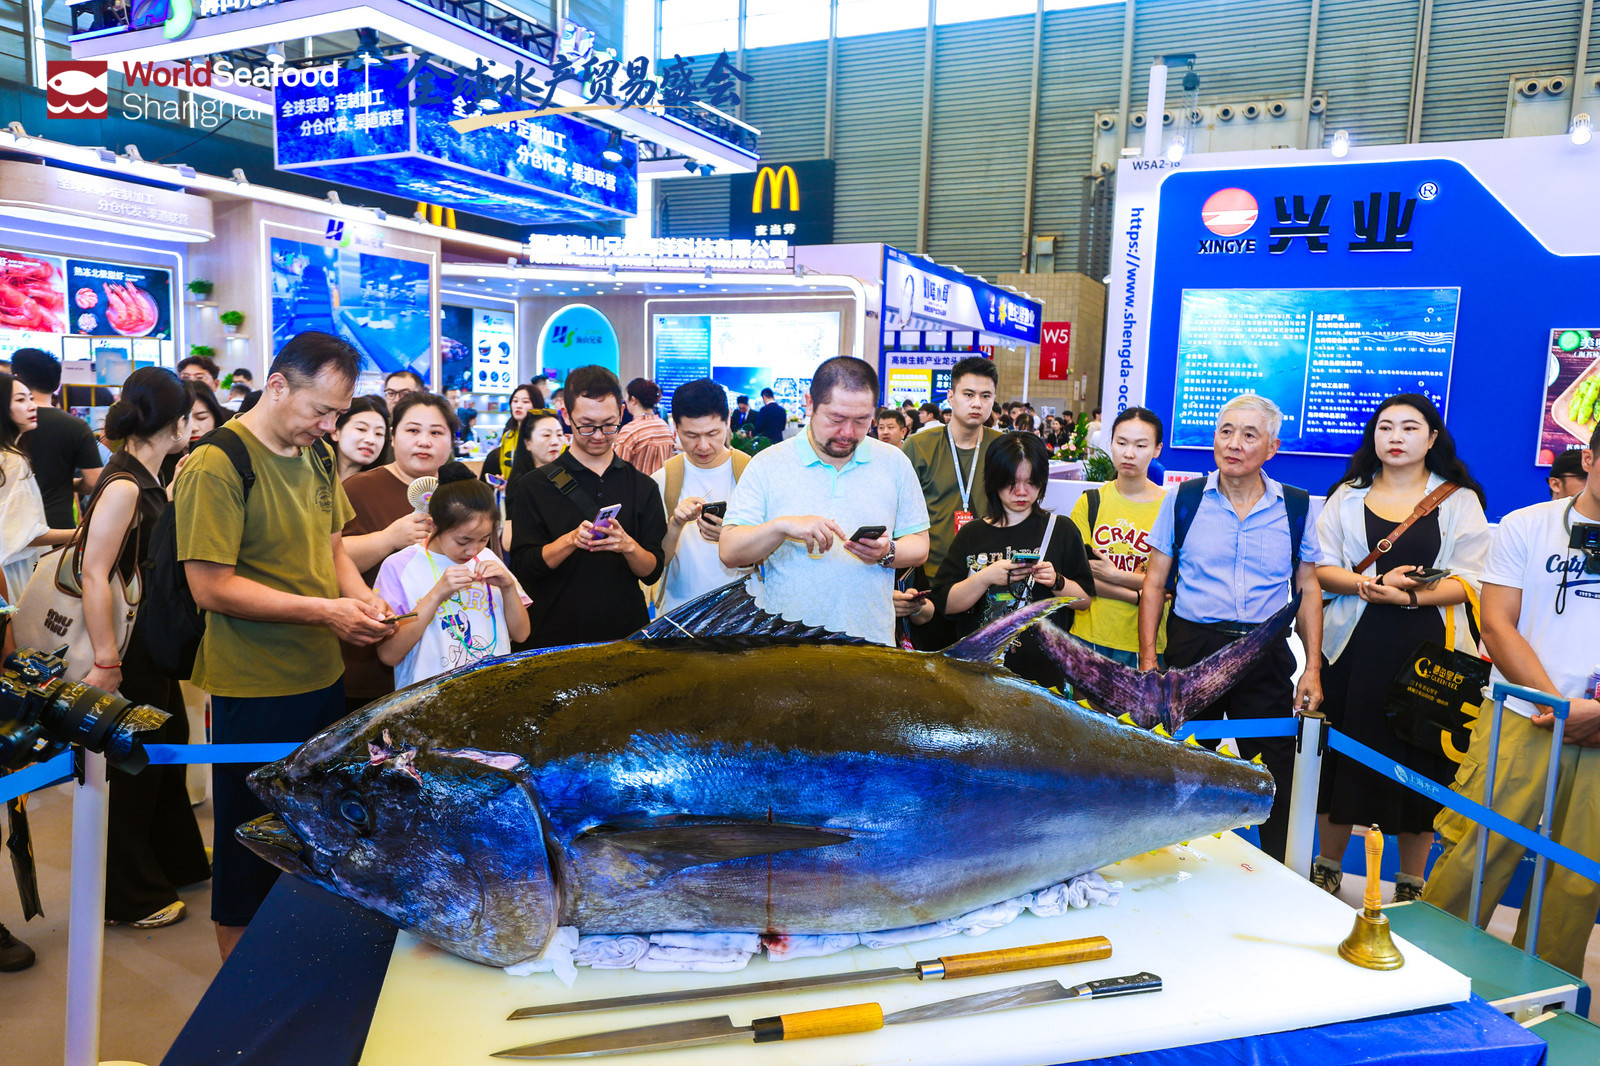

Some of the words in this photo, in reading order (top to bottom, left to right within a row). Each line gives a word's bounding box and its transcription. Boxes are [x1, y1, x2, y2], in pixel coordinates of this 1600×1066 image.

[755, 223, 796, 236] 麦当劳
[1269, 191, 1418, 255] 兴业
[1198, 239, 1258, 255] XINGYE
[1118, 207, 1145, 416] https://www.shengda-oce
[1043, 329, 1069, 344] W5
[1050, 357, 1057, 373] 1
[1115, 518, 1135, 528] The
[1099, 549, 1148, 573] HACK
